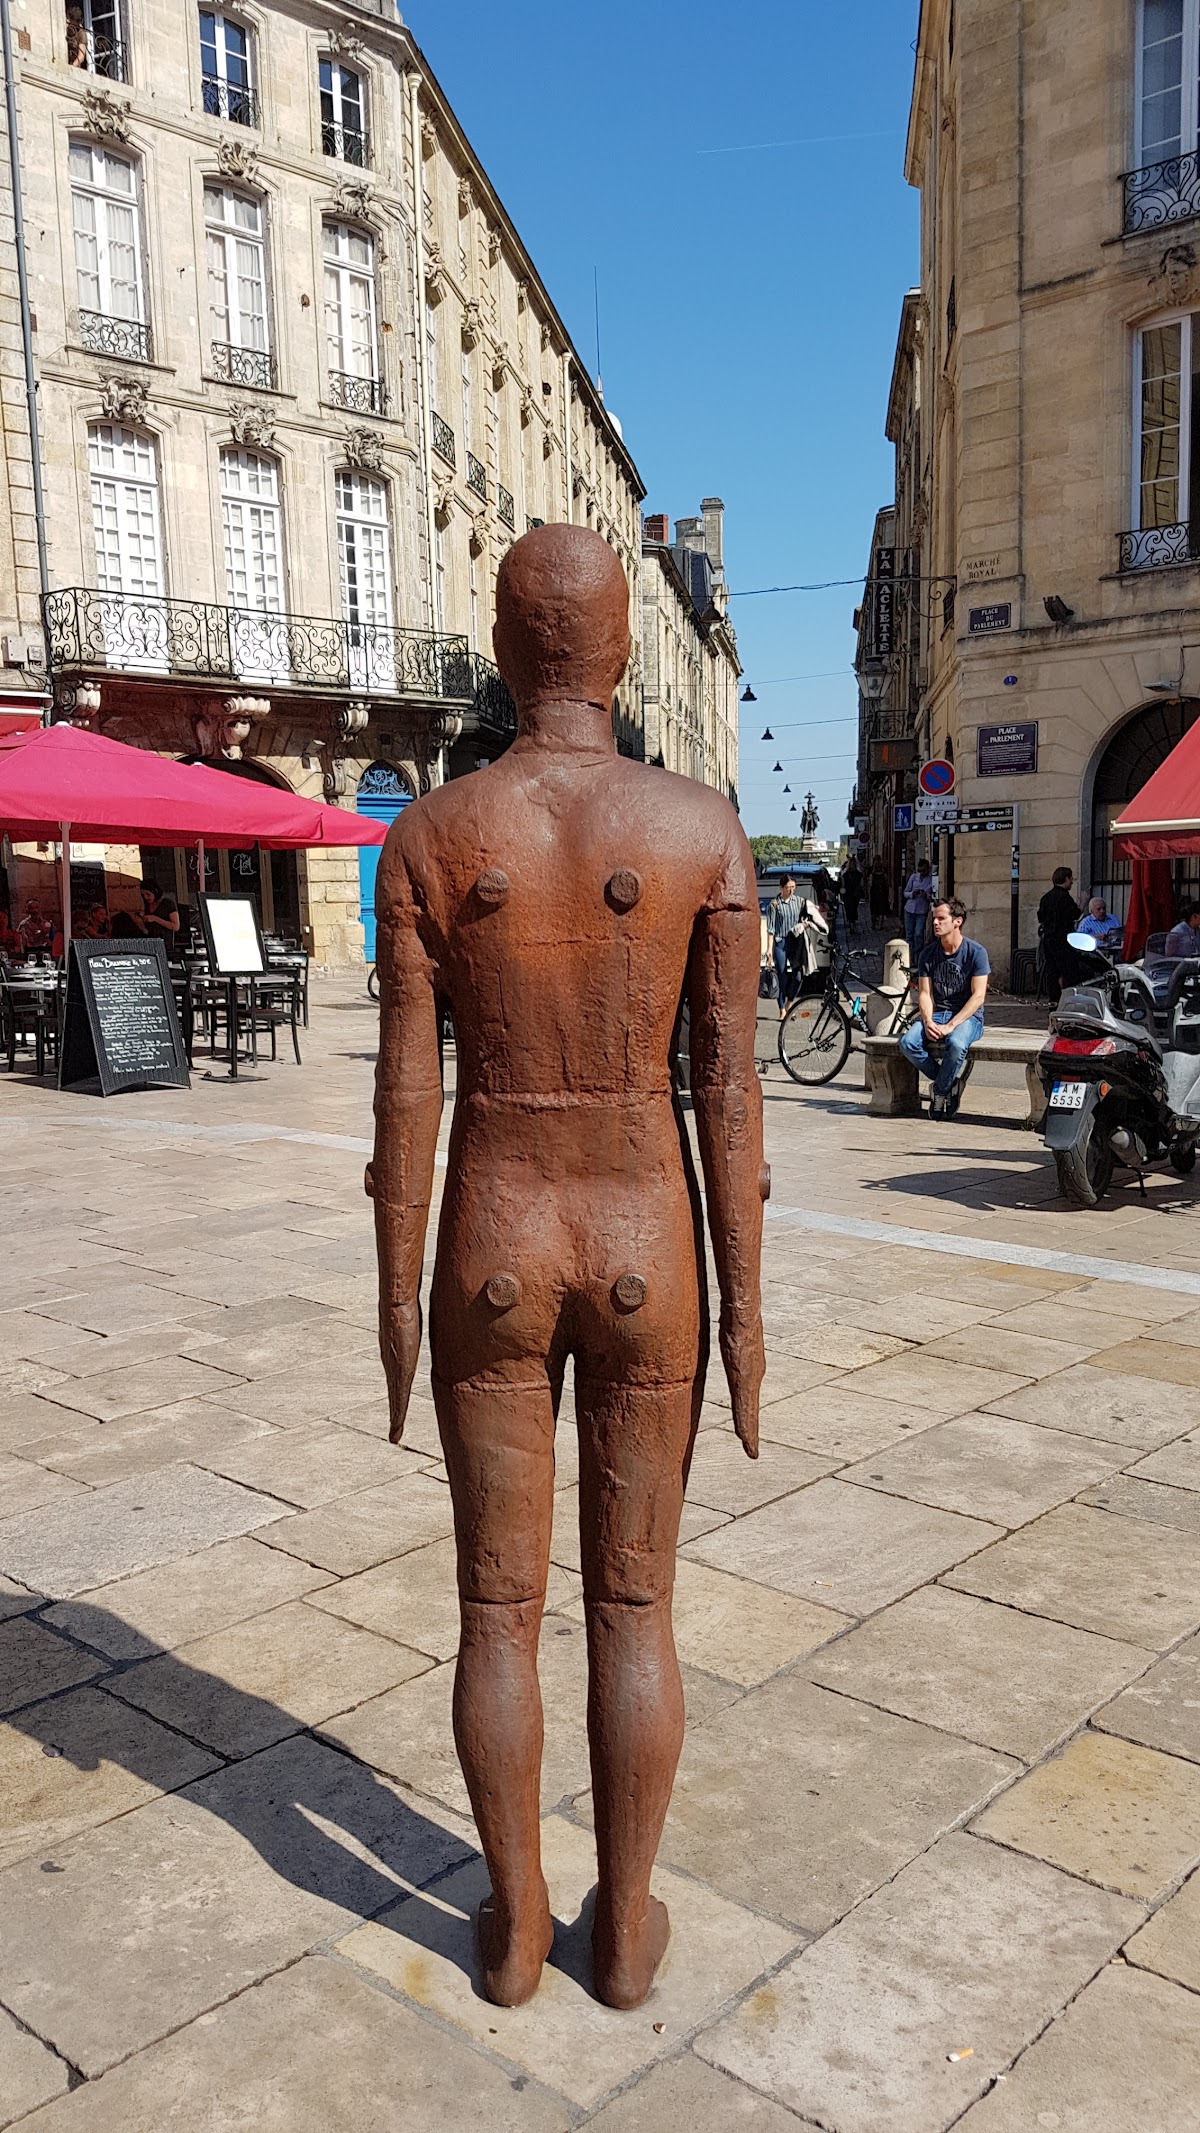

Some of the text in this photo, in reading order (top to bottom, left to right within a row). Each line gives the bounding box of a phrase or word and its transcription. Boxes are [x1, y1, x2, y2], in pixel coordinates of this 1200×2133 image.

[880, 550, 891, 569] LA
[969, 568, 997, 579] ROYAL
[981, 608, 999, 616] PLACE
[974, 620, 1006, 630] PARLEMENT
[998, 727, 1017, 735] PLACE
[990, 734, 1025, 743] PARLEMENT
